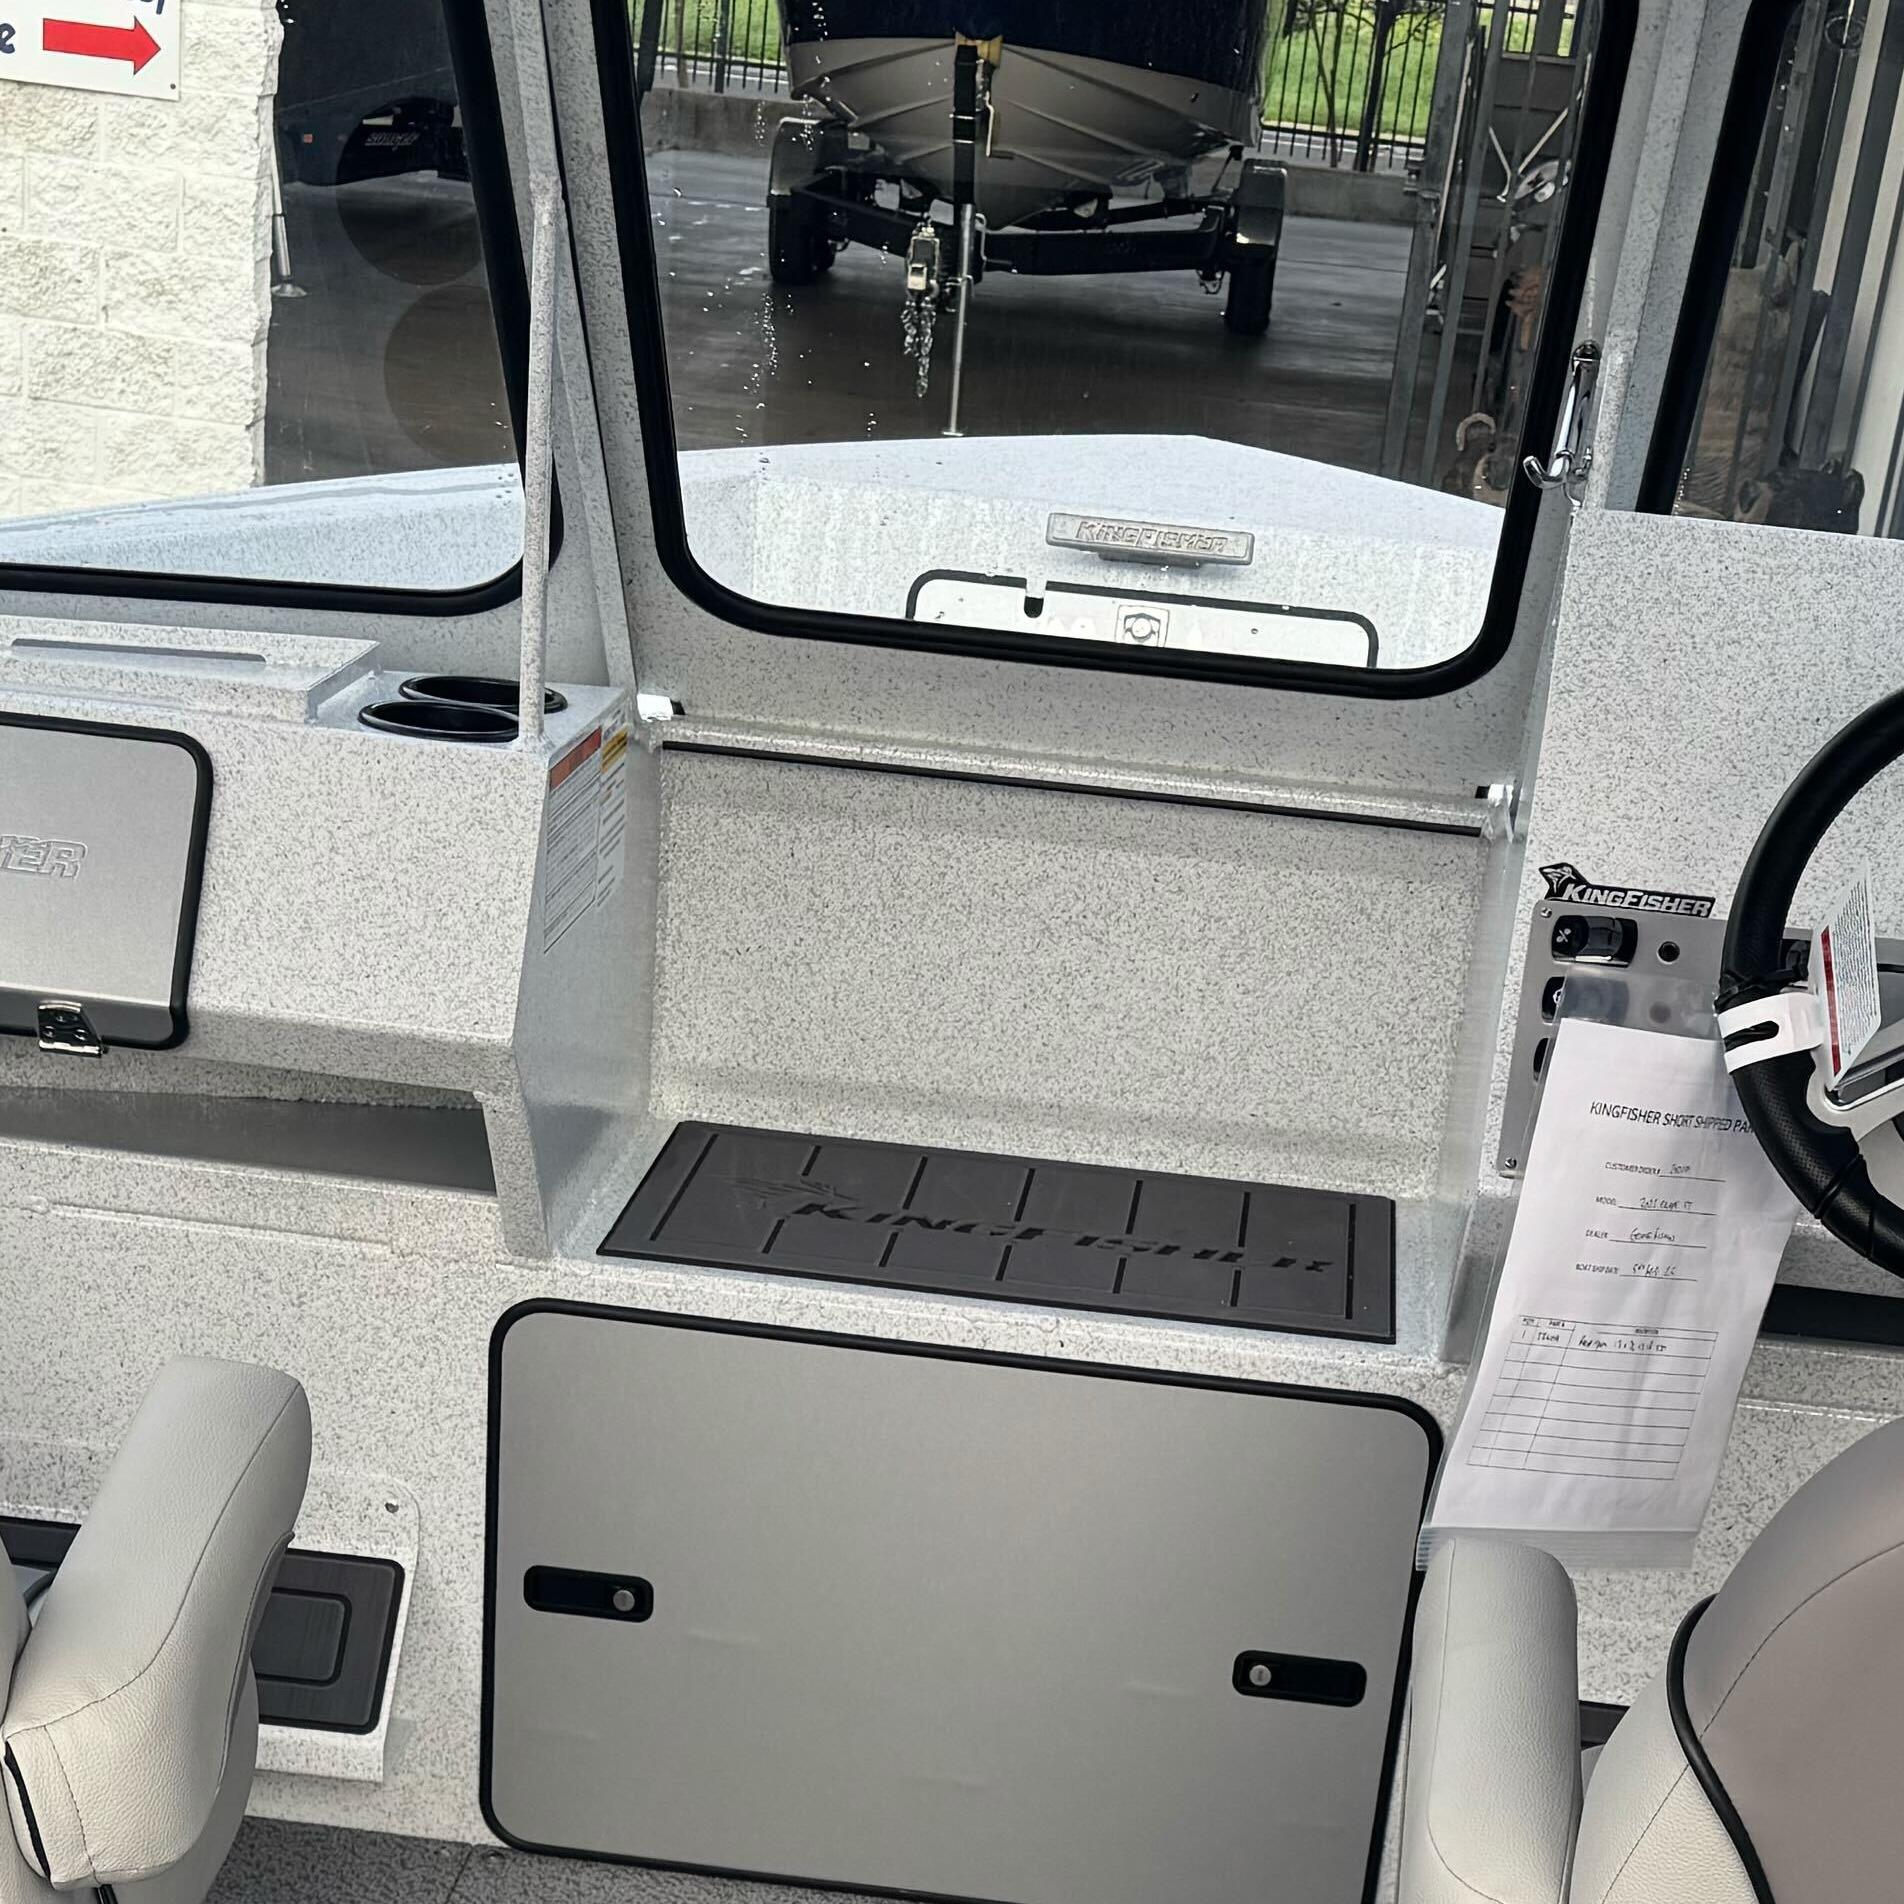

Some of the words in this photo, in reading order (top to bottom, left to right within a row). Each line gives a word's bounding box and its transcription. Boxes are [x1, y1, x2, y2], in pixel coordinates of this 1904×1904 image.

[1564, 884, 1712, 918] KINGFISHER
[1590, 1101, 1661, 1125] KINGFISHER
[1663, 1113, 1695, 1128] SHORT
